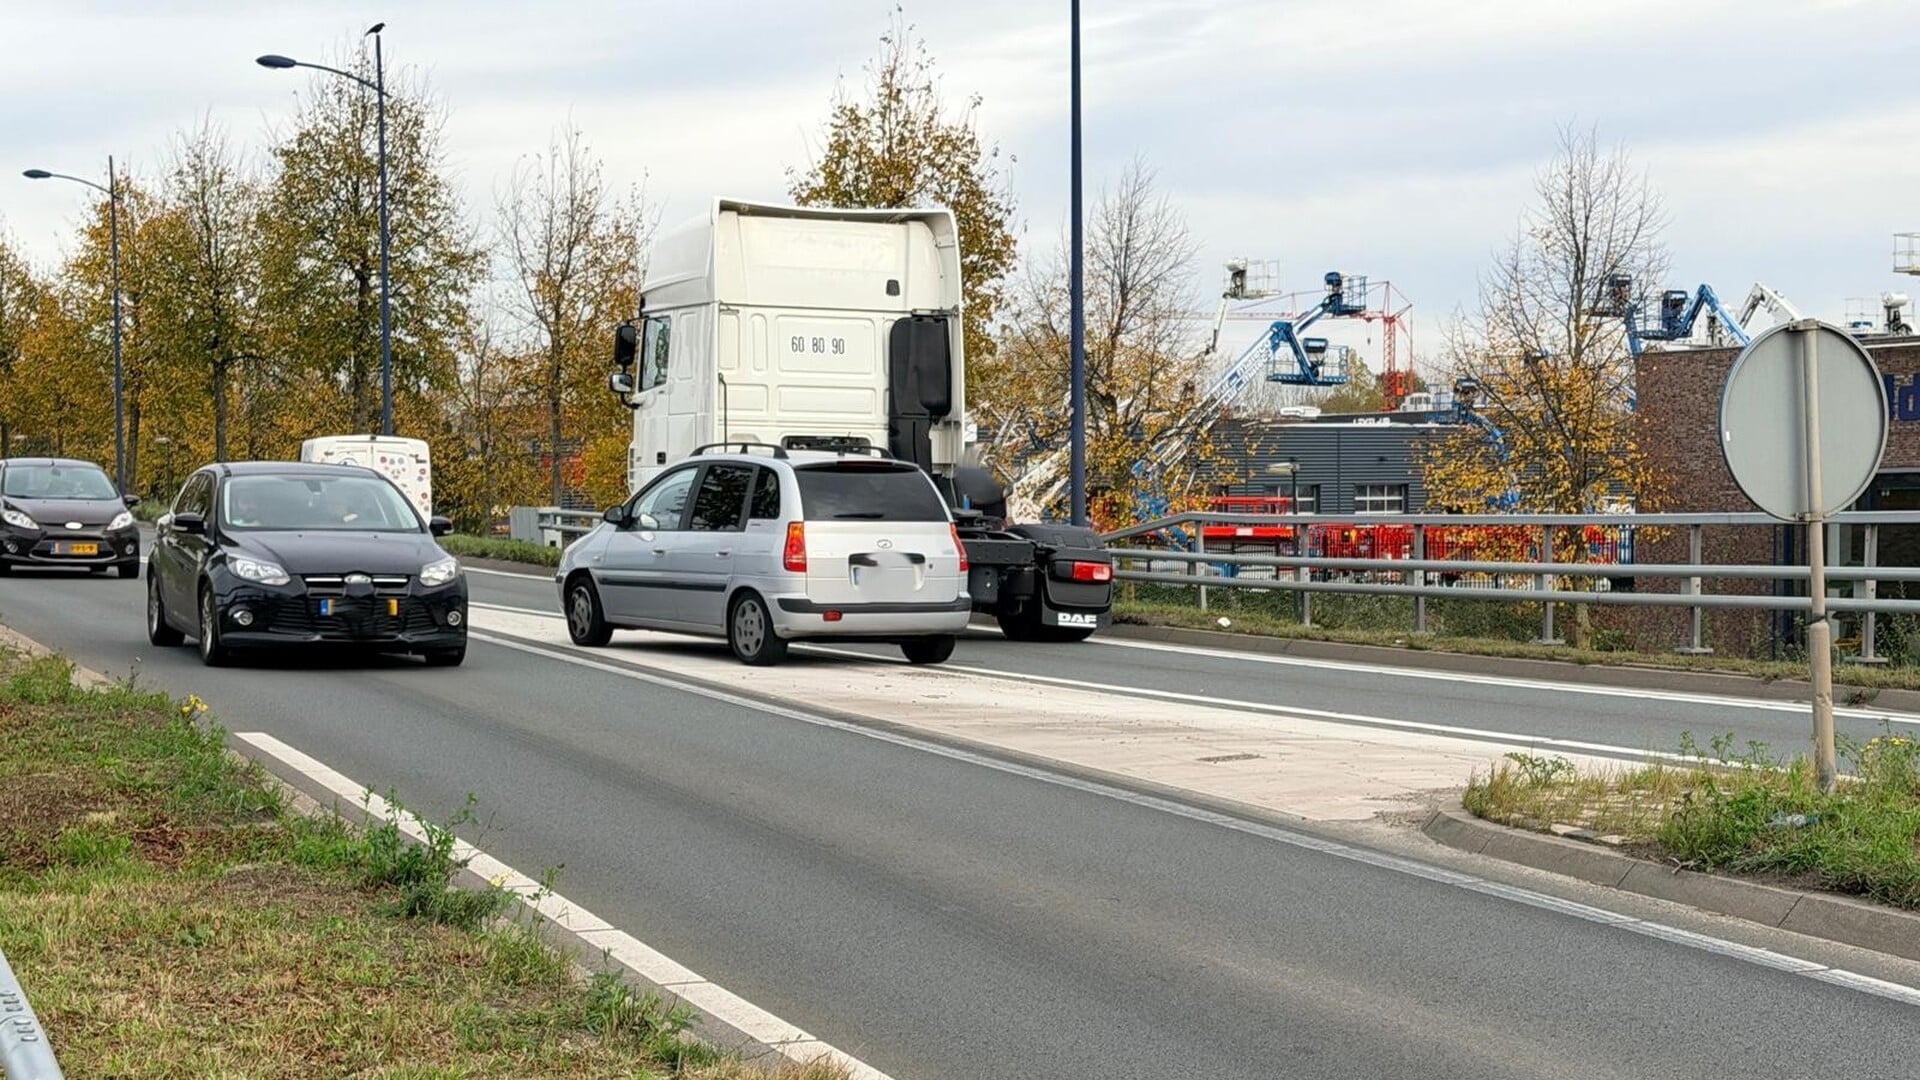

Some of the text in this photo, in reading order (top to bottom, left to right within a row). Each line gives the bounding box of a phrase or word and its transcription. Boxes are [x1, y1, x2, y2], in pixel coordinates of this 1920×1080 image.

[791, 336, 845, 354] 60 80 90
[1058, 612, 1097, 623] DAF
